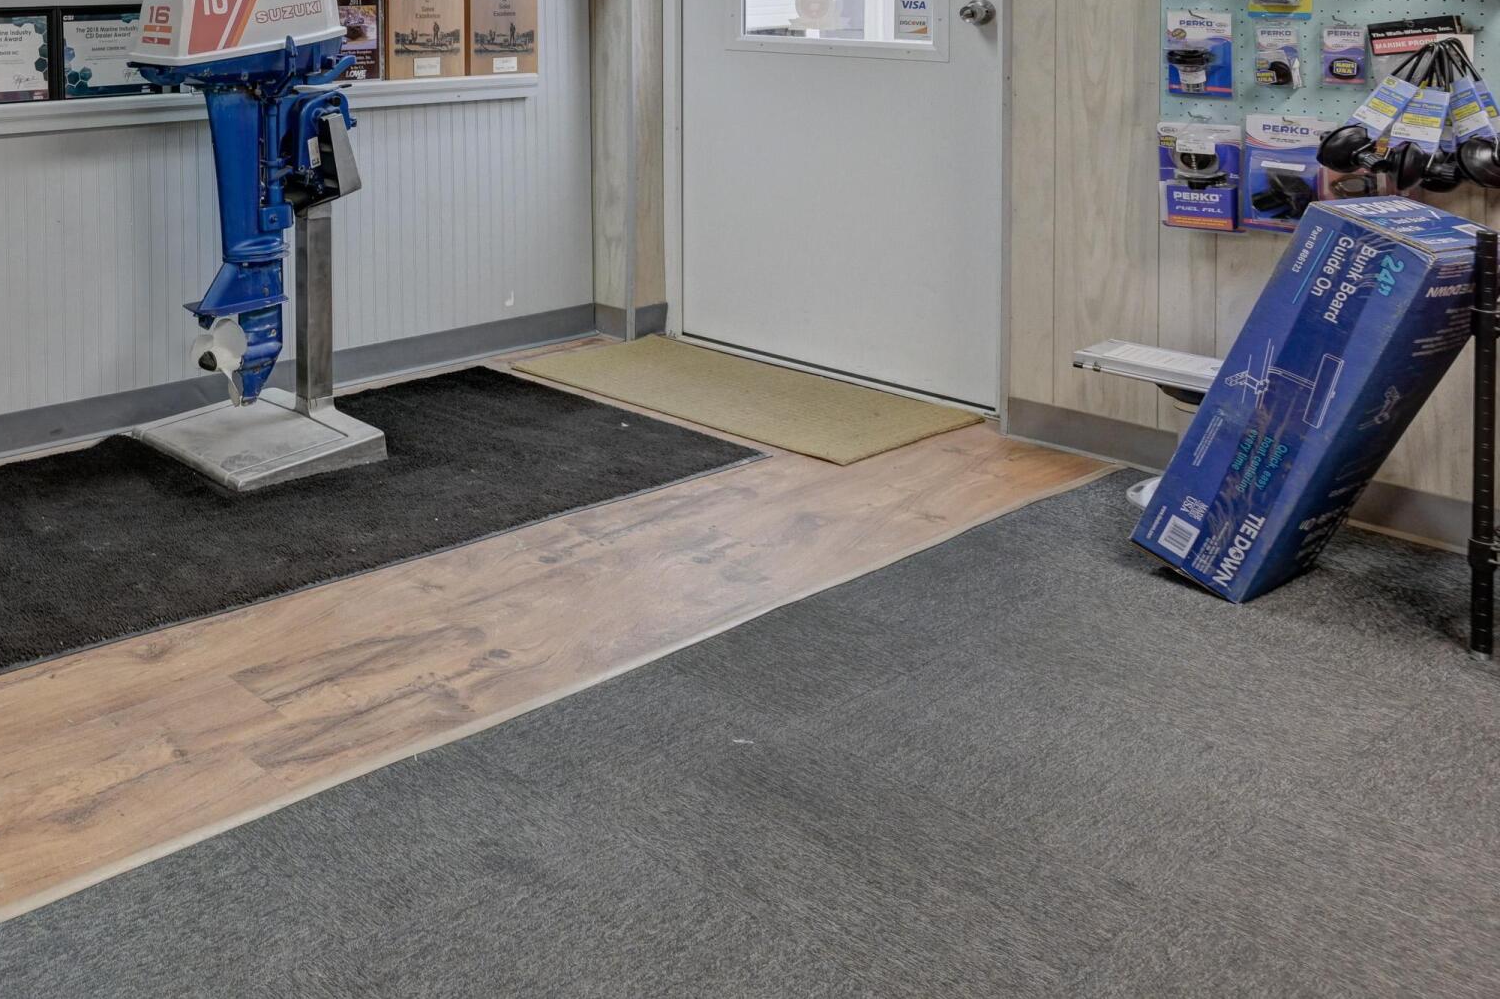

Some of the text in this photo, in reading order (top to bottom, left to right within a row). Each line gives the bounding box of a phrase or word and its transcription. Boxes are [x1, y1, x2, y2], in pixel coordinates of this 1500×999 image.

[254, 0, 323, 24] SUZUKI
[901, 1, 926, 9] VISA
[149, 6, 171, 24] 16
[9, 29, 32, 37] Industry
[1375, 41, 1407, 50] MARINE
[345, 69, 367, 78] LOWE
[1262, 124, 1310, 135] PERKO
[1173, 191, 1220, 202] PERKO
[1309, 225, 1323, 239] Part
[1305, 240, 1315, 249] ID
[1311, 236, 1355, 297] Guide On
[1323, 245, 1377, 324] Bunk Board
[1230, 428, 1259, 471] every time
[1236, 435, 1275, 494] boat centering
[1255, 444, 1288, 491] Quick, easy
[1180, 495, 1194, 512] USA
